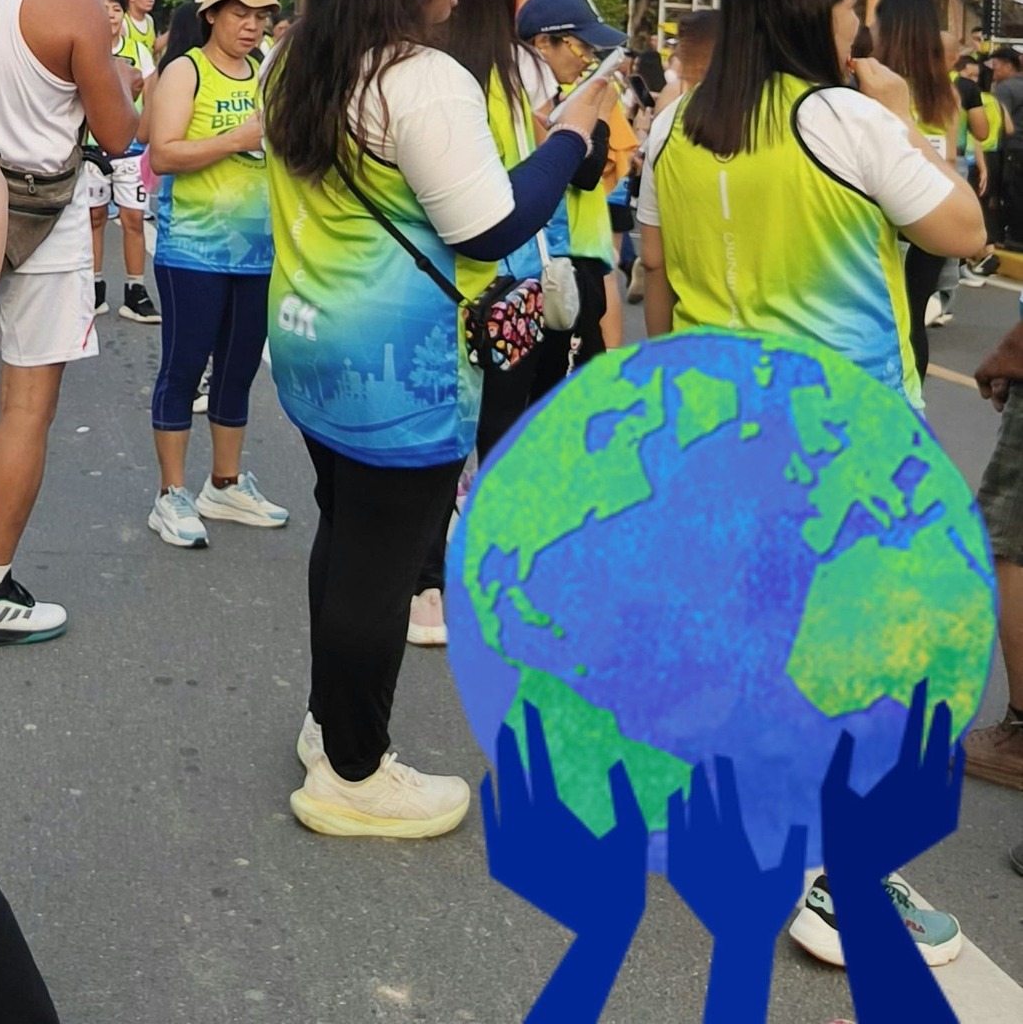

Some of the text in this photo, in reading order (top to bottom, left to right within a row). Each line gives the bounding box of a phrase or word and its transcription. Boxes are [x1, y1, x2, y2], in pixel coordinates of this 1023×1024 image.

[216, 98, 256, 113] RUN
[210, 113, 251, 129] BEY
[278, 294, 319, 342] 6K
